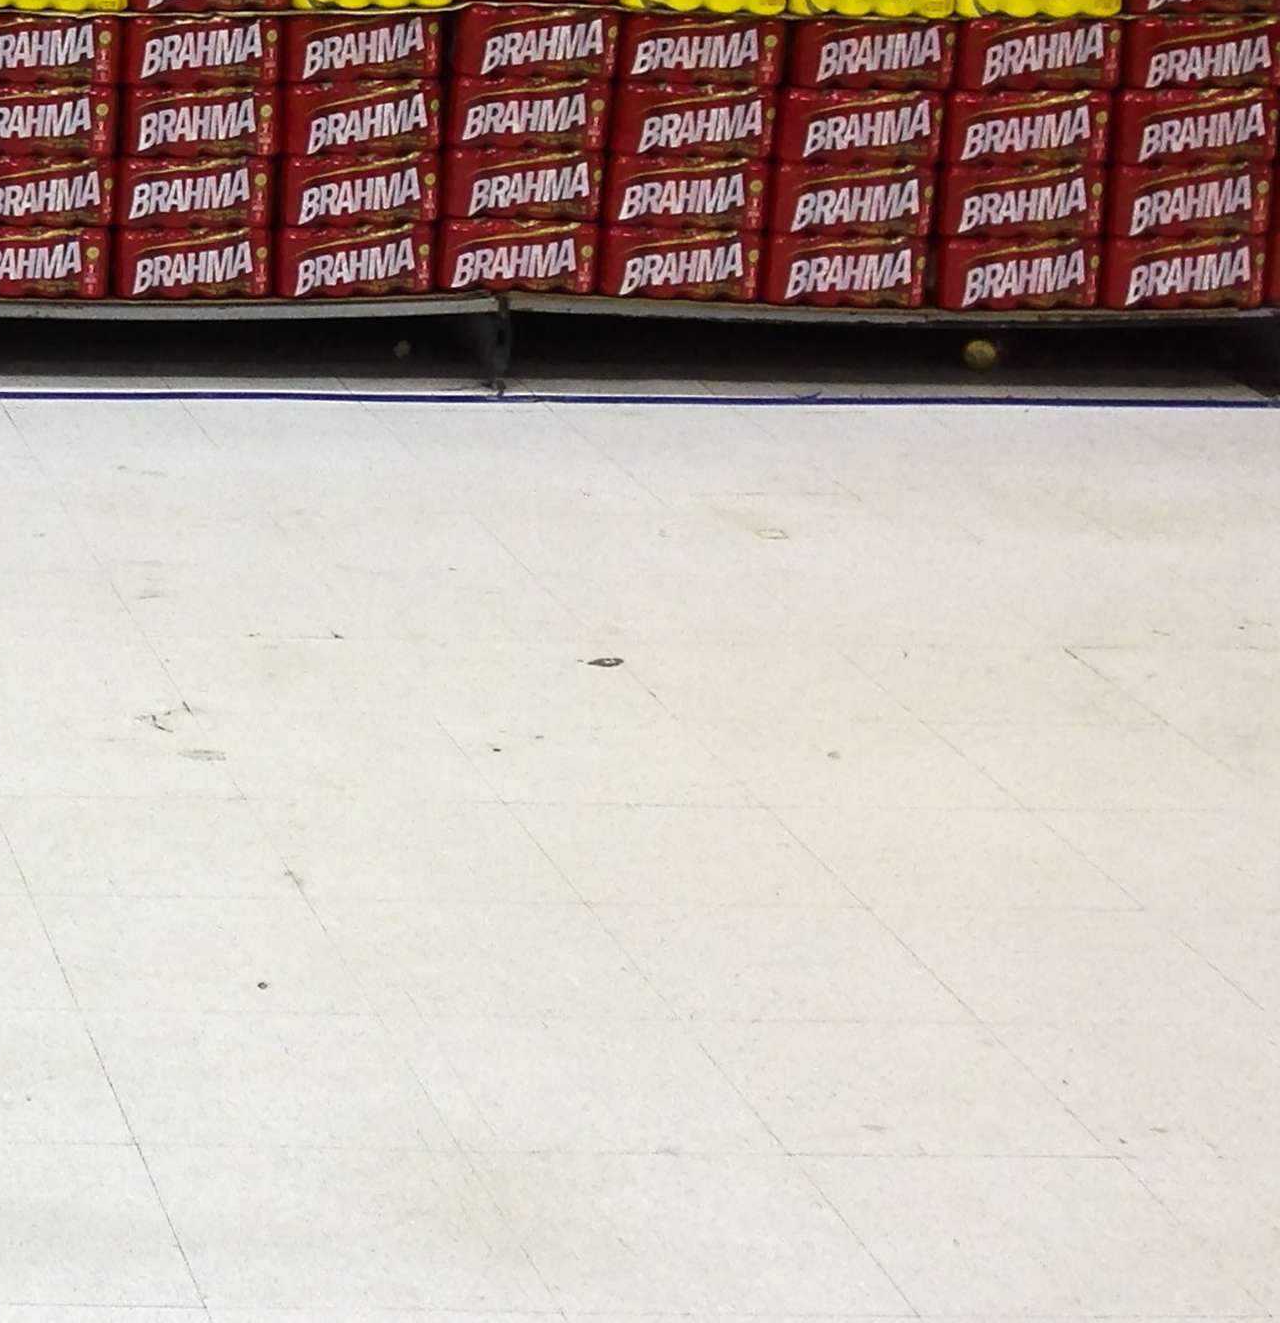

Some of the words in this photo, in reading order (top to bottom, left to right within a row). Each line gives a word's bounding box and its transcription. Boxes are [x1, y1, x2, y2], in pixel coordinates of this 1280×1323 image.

[140, 19, 263, 79] BRAHMA
[480, 19, 603, 75] BRAHMA
[982, 23, 1109, 85] BRAHMA
[803, 94, 930, 157] BRAHMA
[1138, 103, 1265, 162] BRAHMA
[128, 159, 250, 219] BRAHMA
[468, 162, 590, 216] BRAHMA
[294, 238, 415, 296] BRAHMA
[784, 249, 911, 299] BRAHMA
[1125, 246, 1250, 305] BRAHMA
